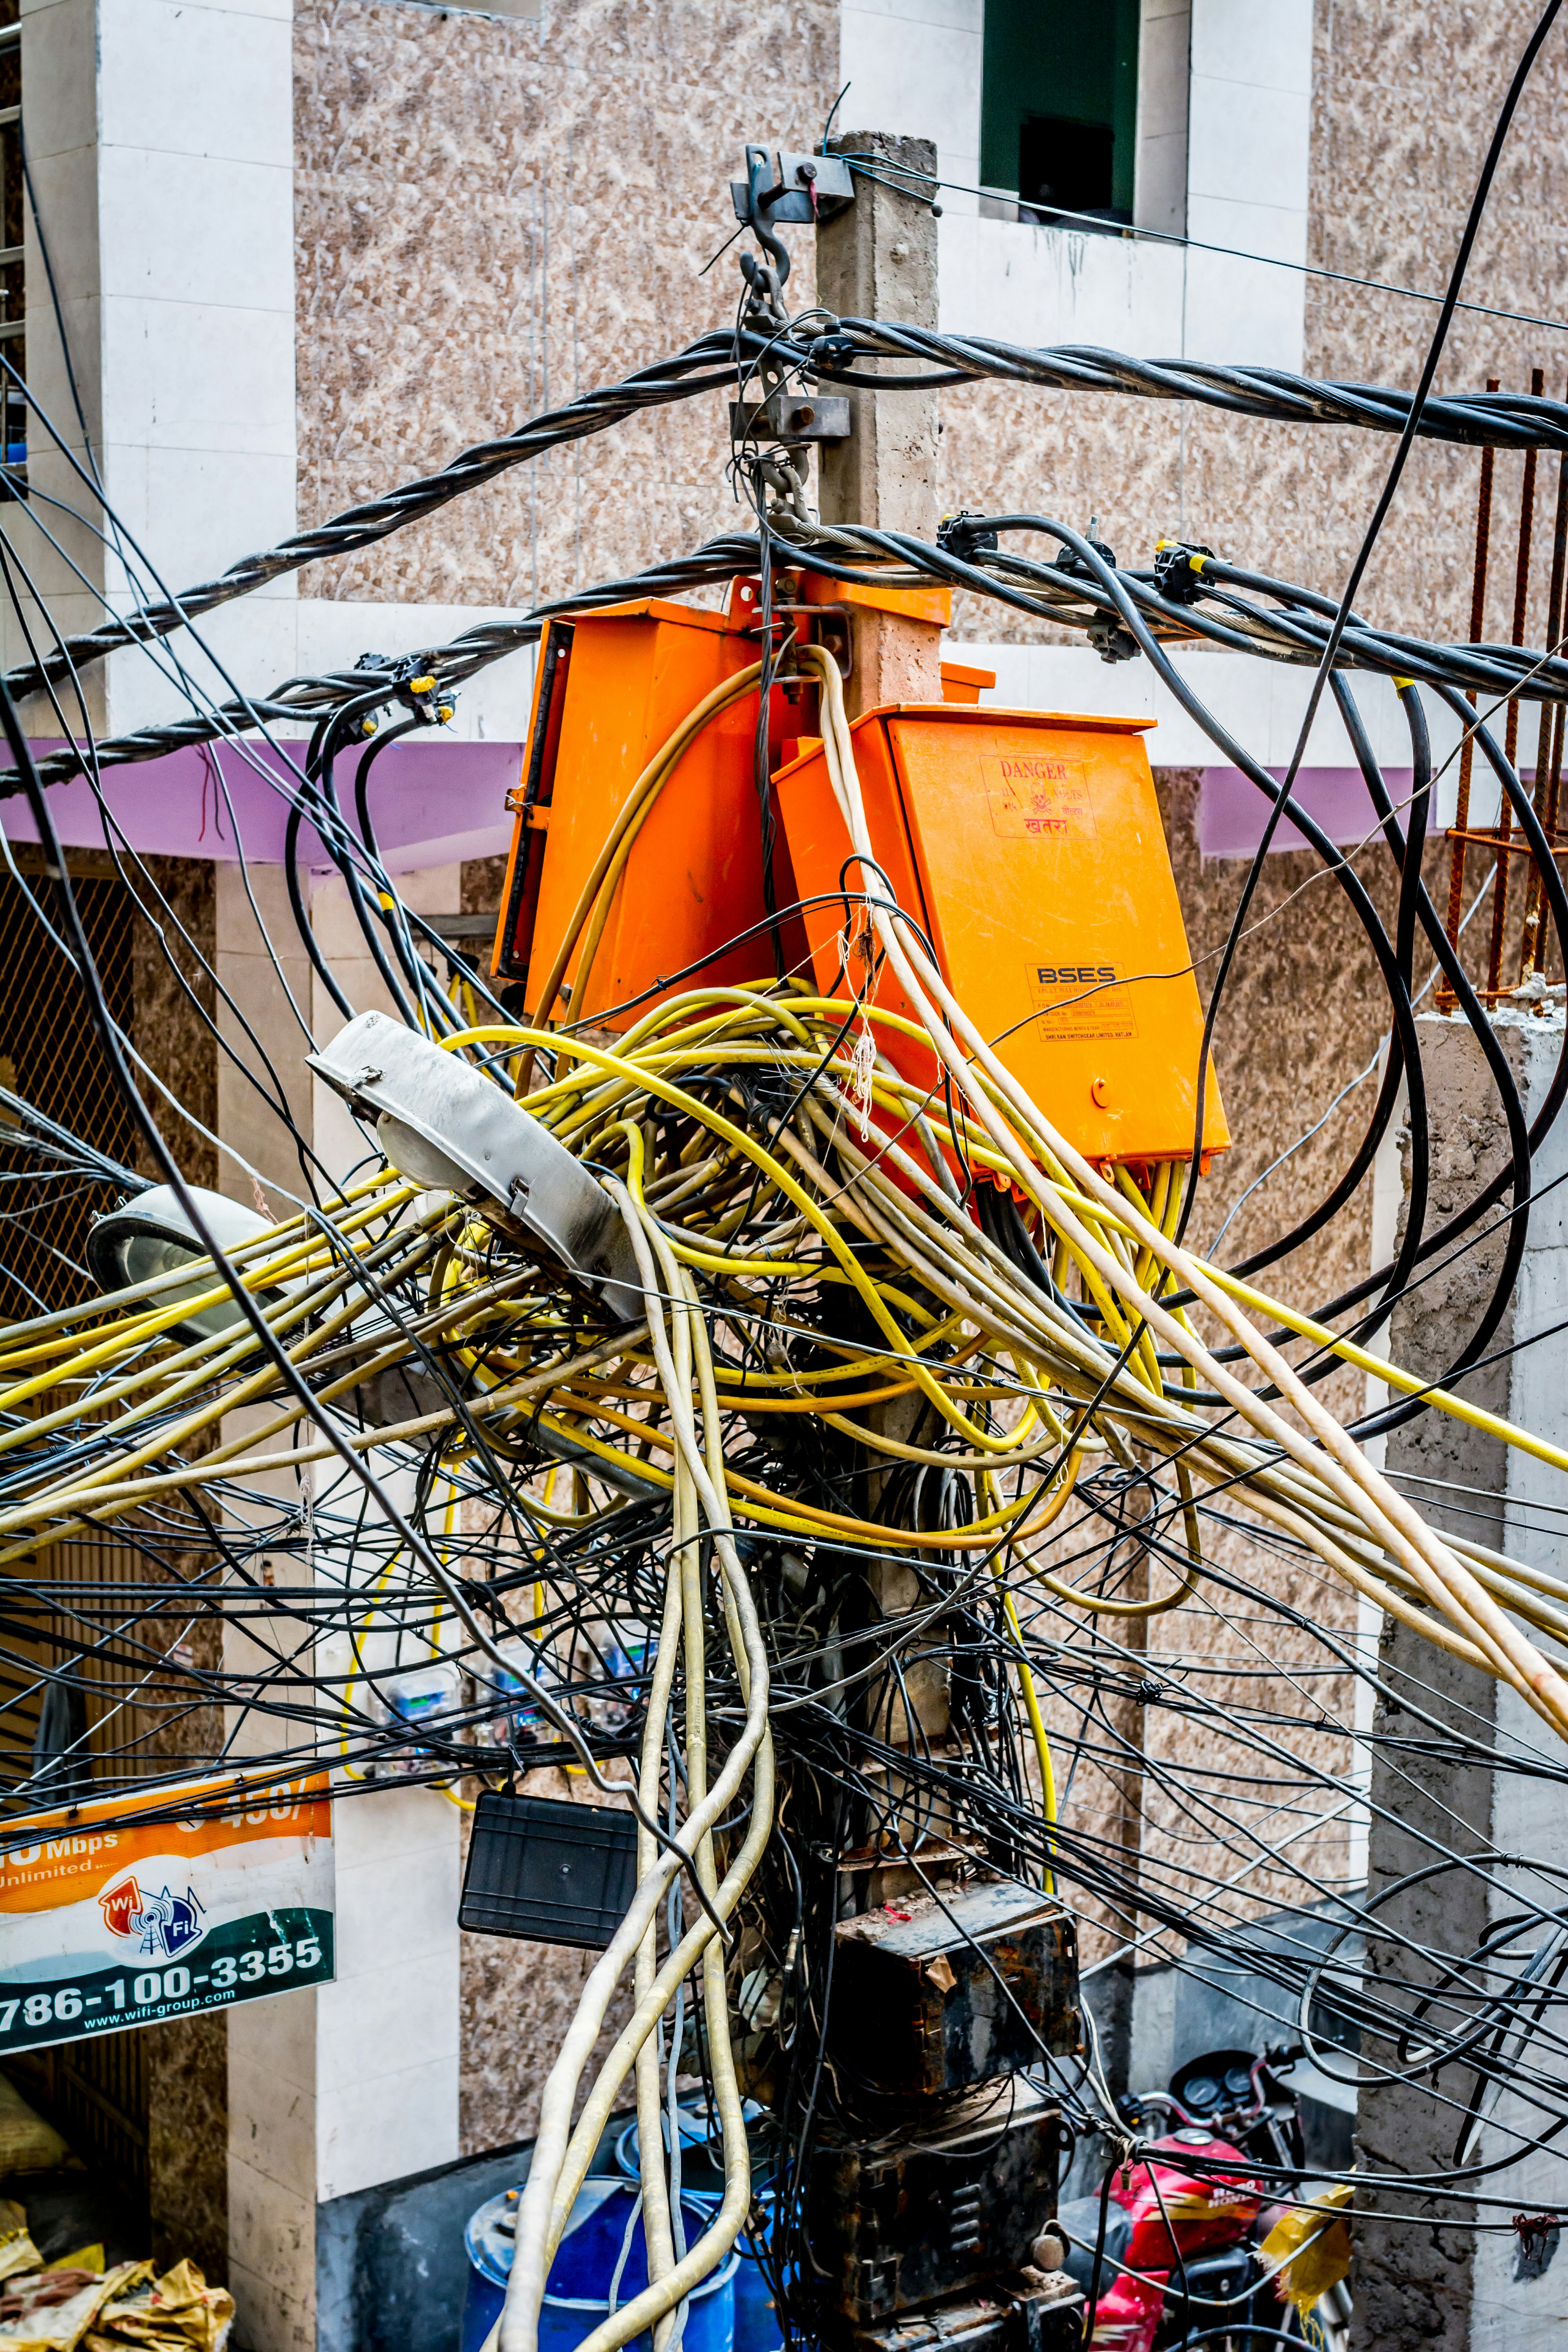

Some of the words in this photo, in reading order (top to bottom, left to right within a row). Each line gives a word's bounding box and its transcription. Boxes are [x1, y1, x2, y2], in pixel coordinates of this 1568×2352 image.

[1000, 760, 1068, 780] DANGER
[1053, 789, 1083, 800] VOLTS
[1024, 818, 1068, 835] खतरा
[1037, 967, 1116, 984] BSES
[47, 1834, 118, 1859] Mbps
[111, 1896, 134, 1912] Wi
[172, 1920, 189, 1937] Fi
[83, 1989, 236, 2030] www.wifi-group.com
